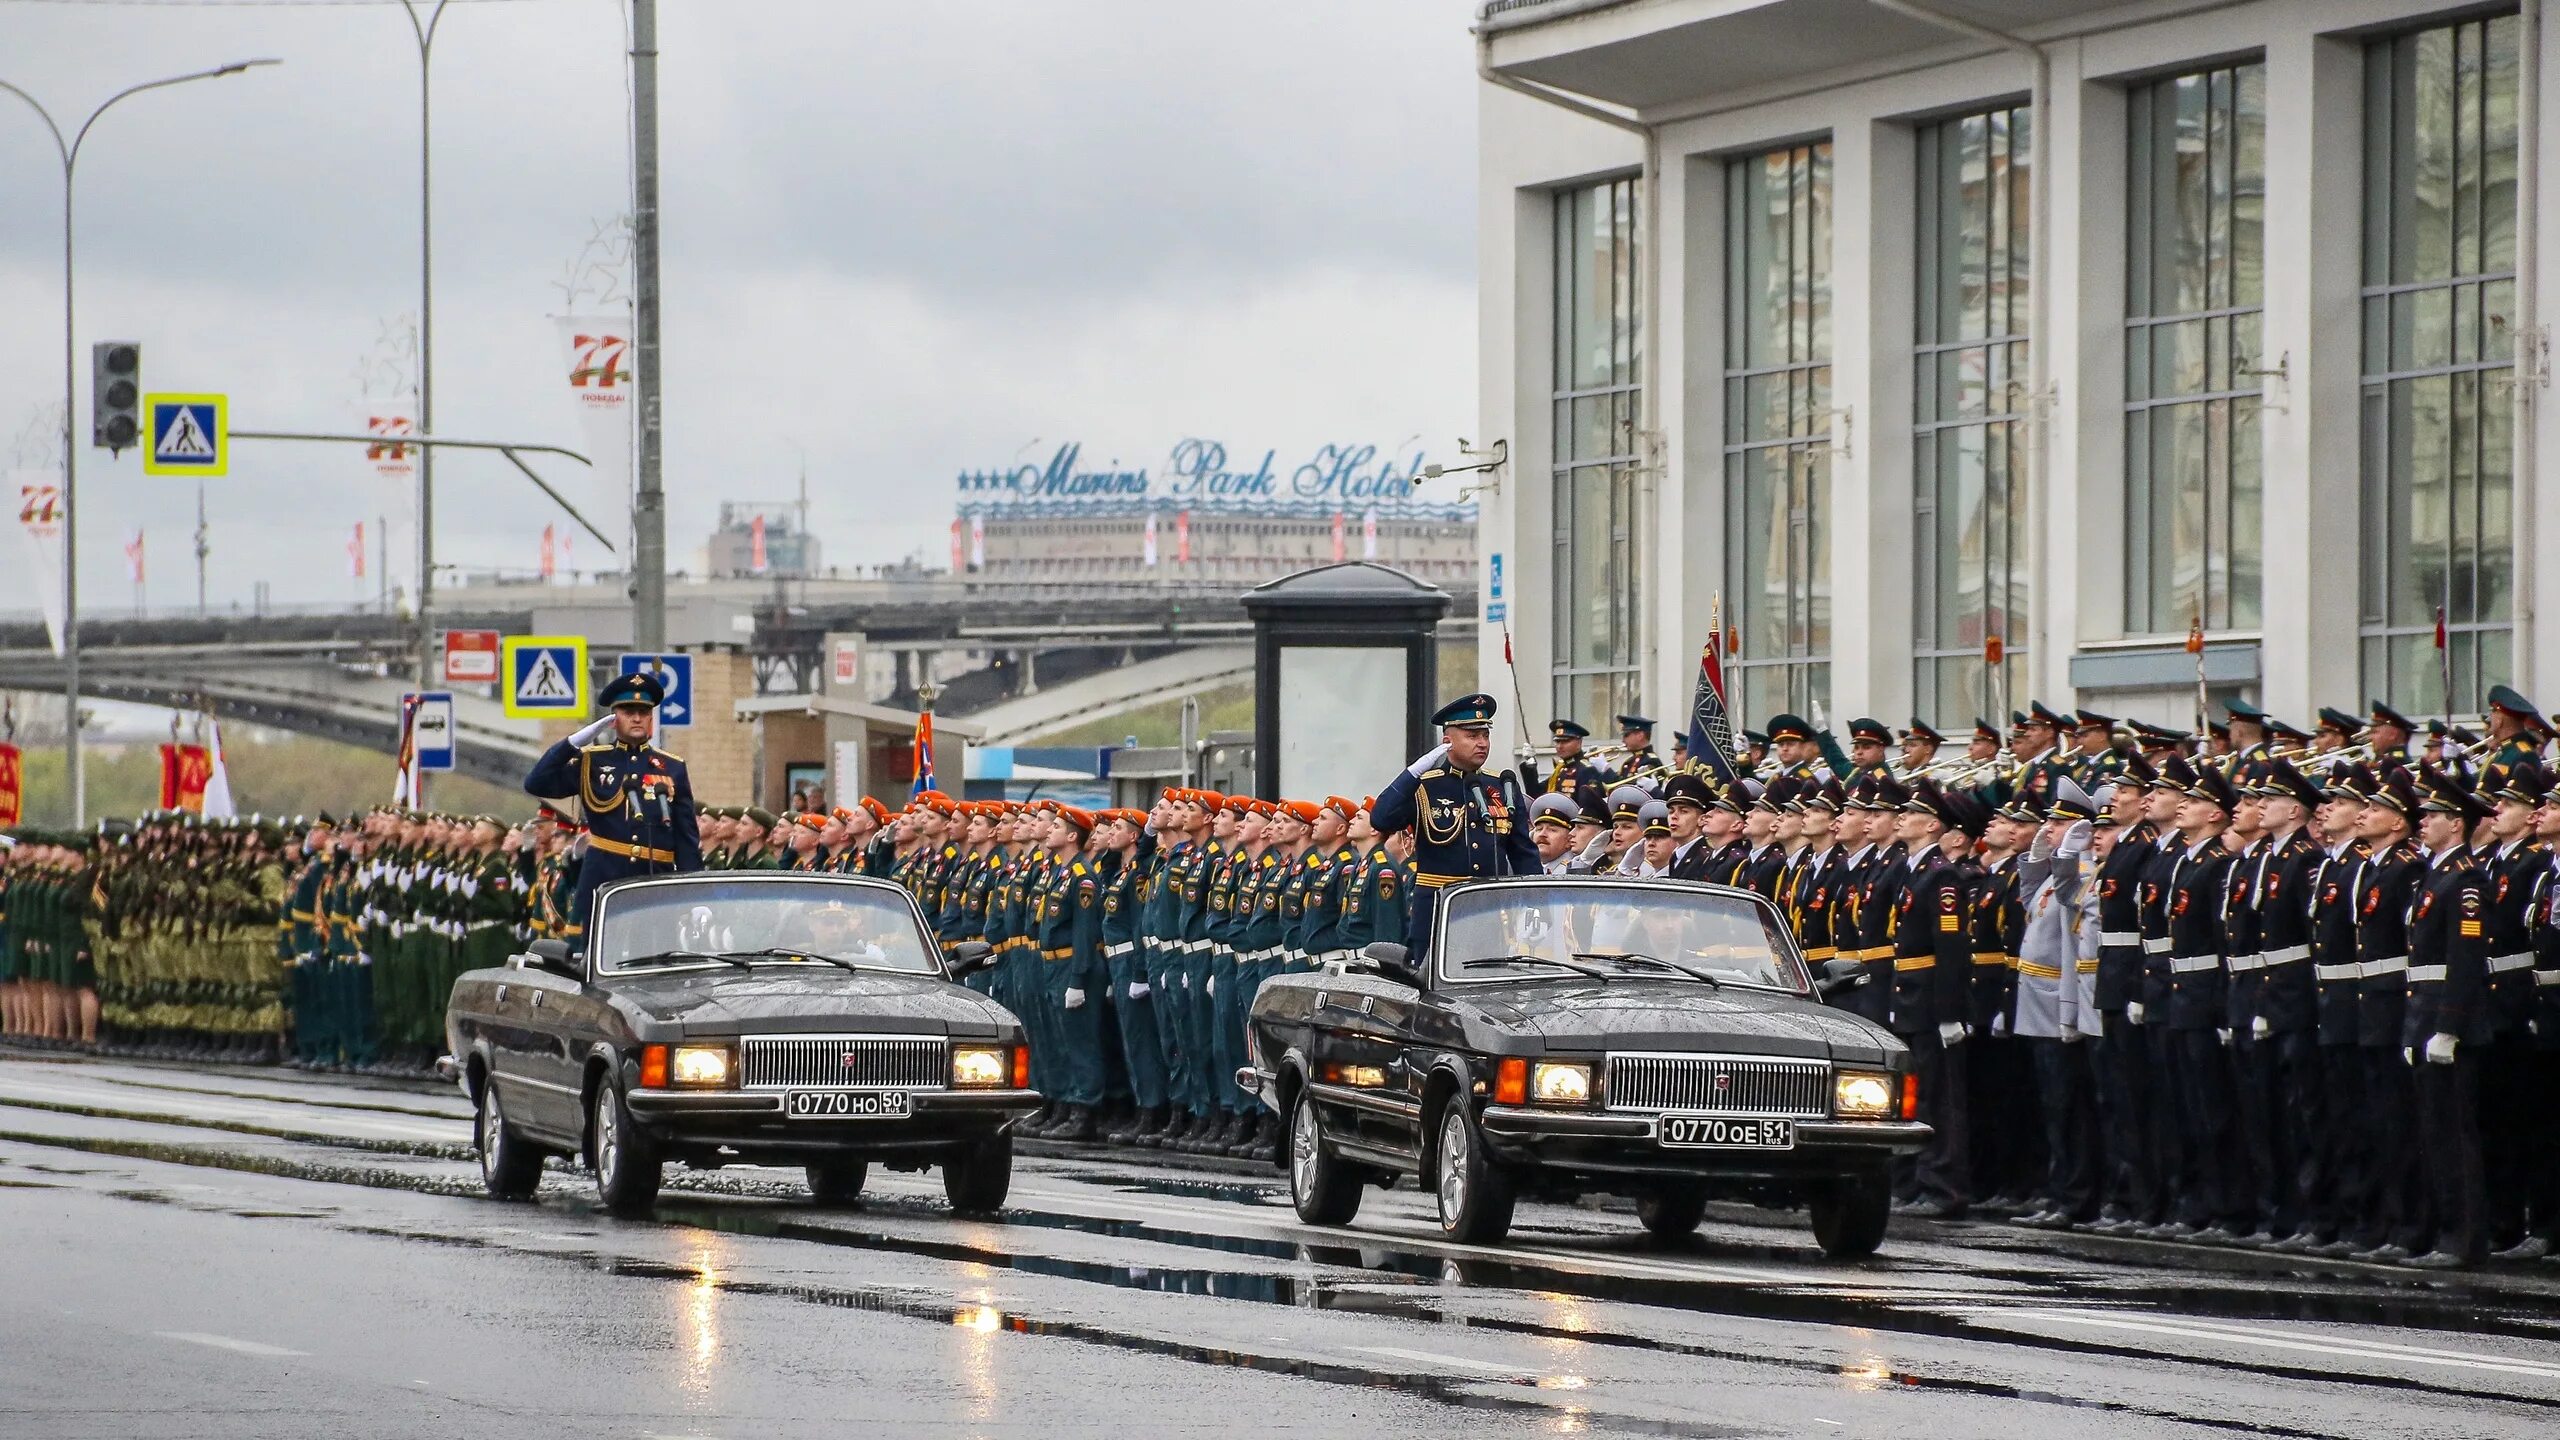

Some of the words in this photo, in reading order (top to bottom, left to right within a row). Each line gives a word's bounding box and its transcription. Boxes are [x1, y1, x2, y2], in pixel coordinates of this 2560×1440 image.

[571, 335, 627, 387] 77
[368, 416, 411, 460] 77
[1018, 441, 1149, 497] Marins
[1171, 438, 1276, 495] Park
[1293, 443, 1425, 497] Hotel
[20, 485, 59, 523] 77
[797, 1093, 849, 1113] 0770
[882, 1092, 903, 1107] 50
[1671, 1119, 1727, 1142] 0770
[1763, 1122, 1784, 1138] 51
